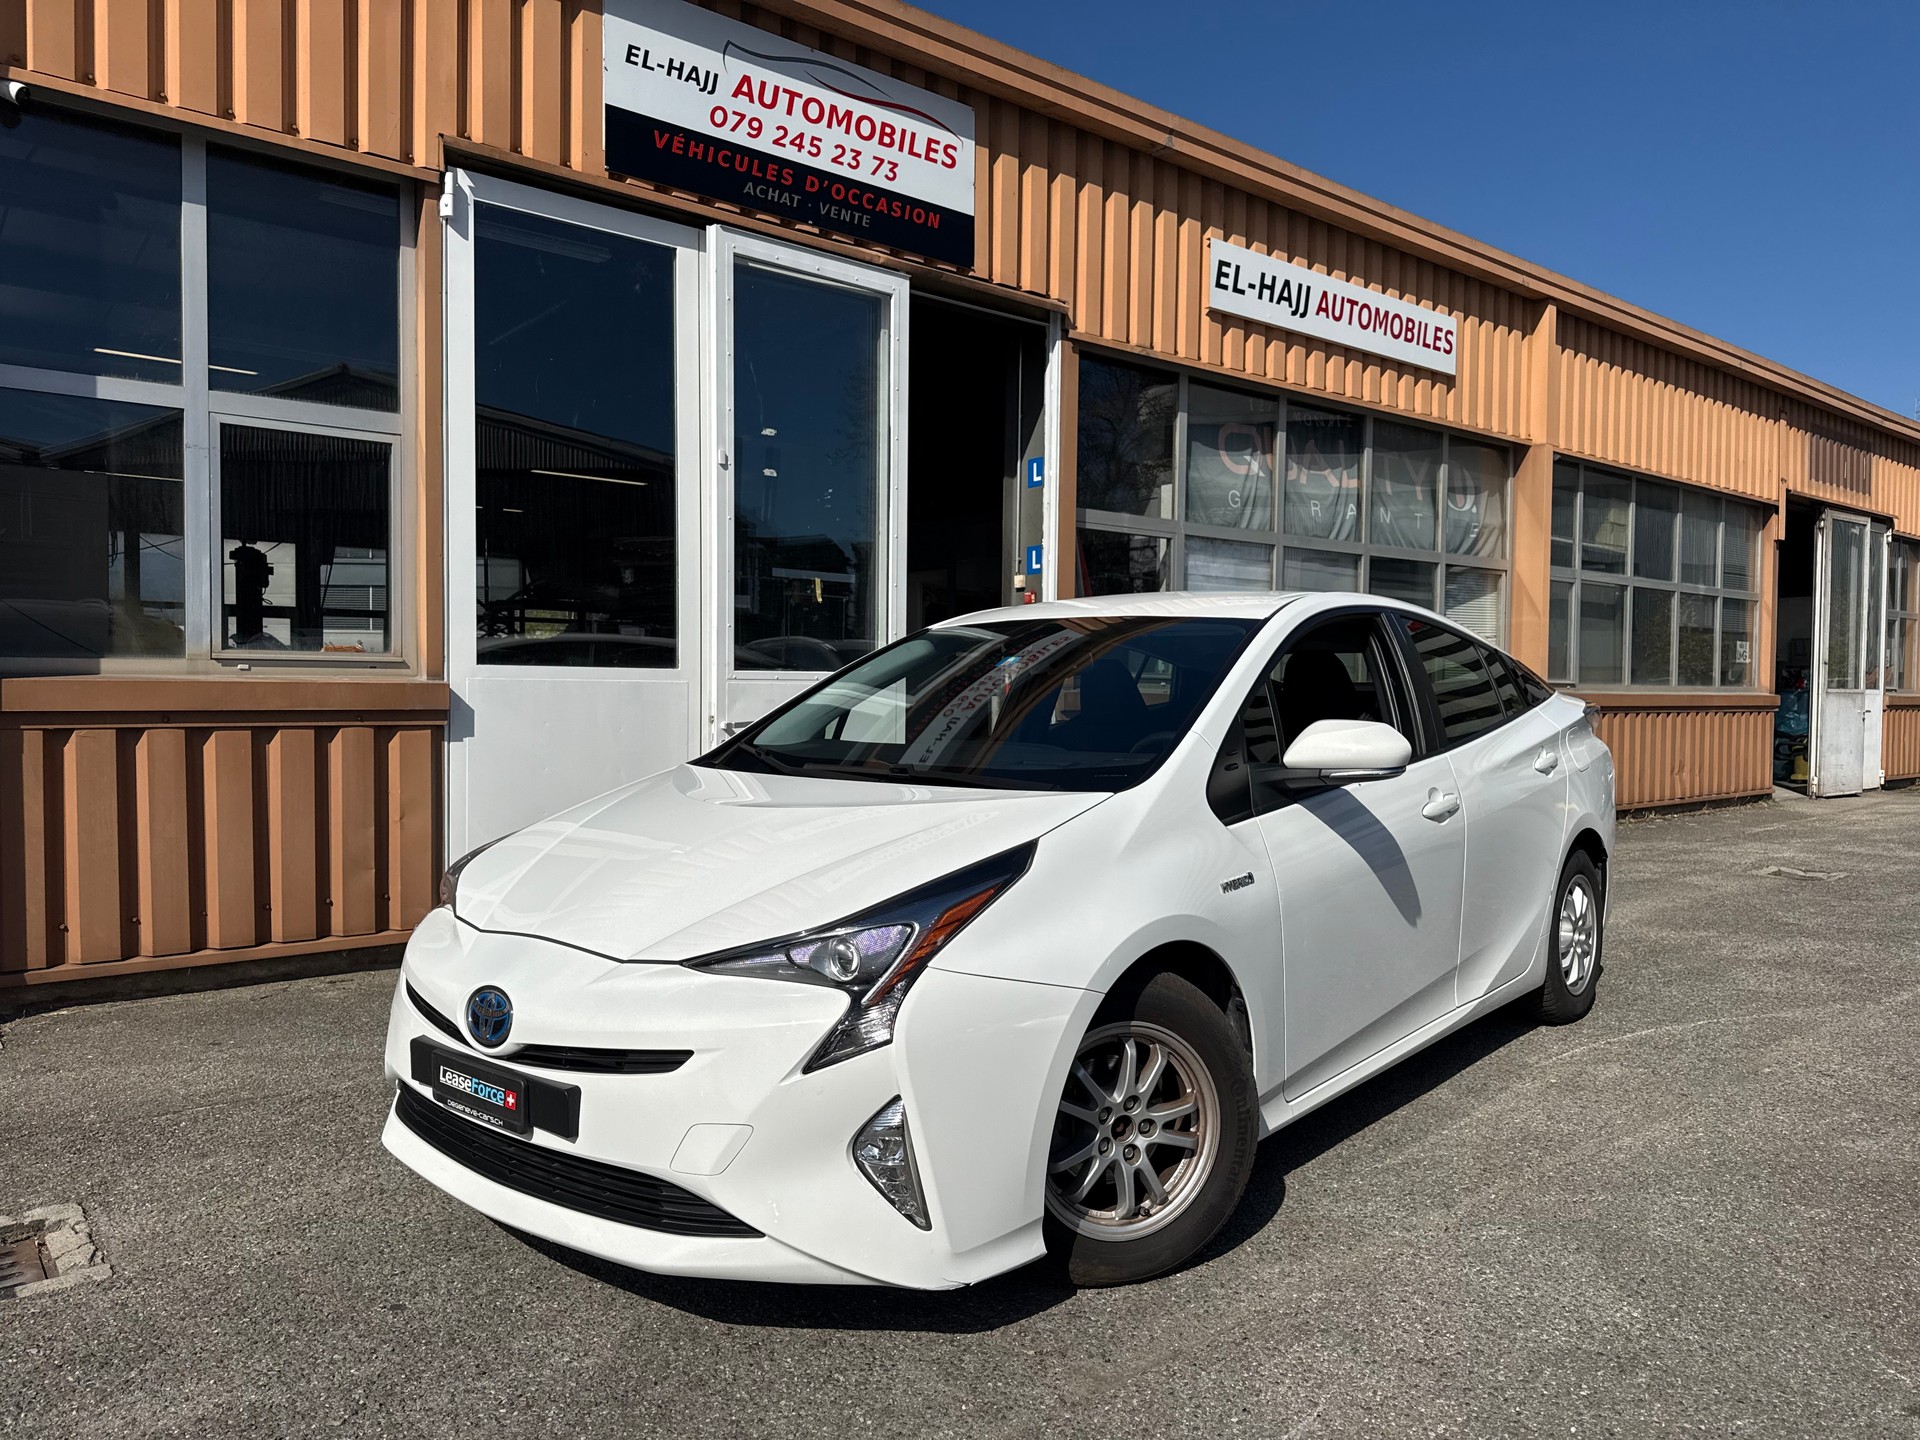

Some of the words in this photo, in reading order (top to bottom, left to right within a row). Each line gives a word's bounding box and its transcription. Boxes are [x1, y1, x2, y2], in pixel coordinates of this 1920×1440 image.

[625, 43, 719, 96] EL-HAJJ
[731, 74, 958, 171] AUTOMOBILES
[709, 105, 764, 139] 079
[772, 125, 822, 158] 245
[831, 144, 861, 171] 23
[871, 155, 899, 182] 73
[654, 129, 794, 186] VÉHICULES
[805, 174, 941, 229] D'OCCASION
[743, 181, 801, 208] ACHAT
[819, 201, 871, 228] VENTE
[1214, 259, 1311, 319] EL-HAJJ
[1315, 290, 1454, 355] AUTOMOBILES
[1033, 463, 1042, 482] L
[1032, 550, 1041, 569] L
[440, 1065, 504, 1104] LeaseForce
